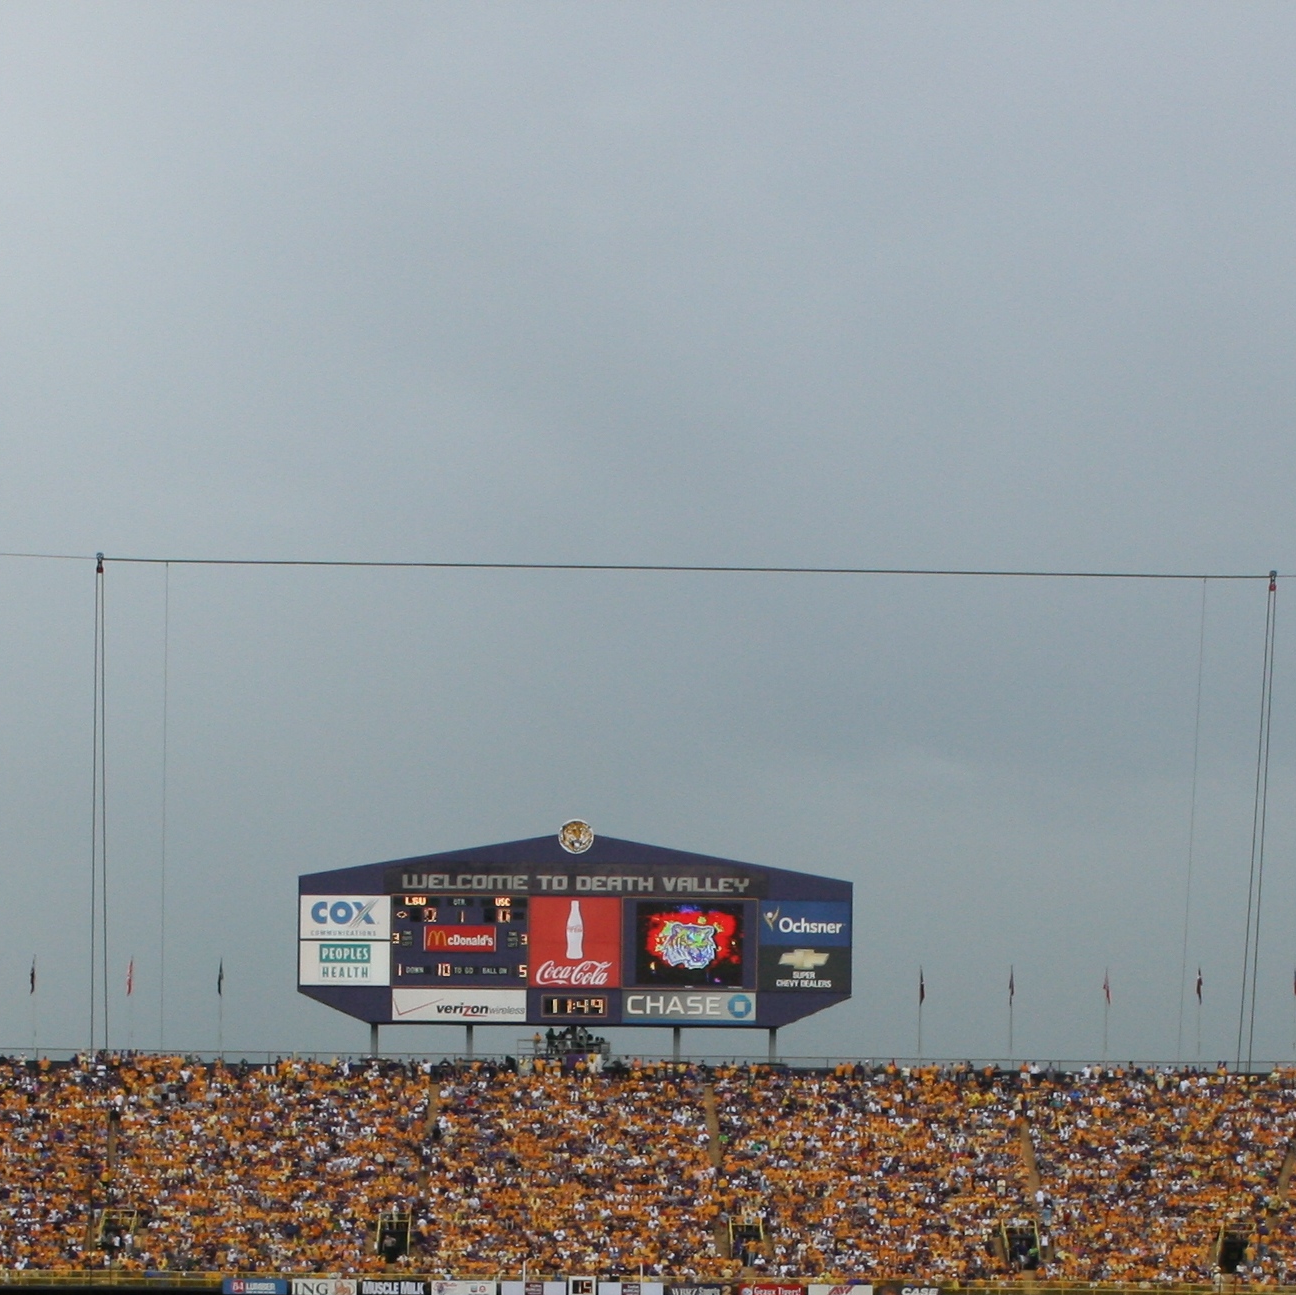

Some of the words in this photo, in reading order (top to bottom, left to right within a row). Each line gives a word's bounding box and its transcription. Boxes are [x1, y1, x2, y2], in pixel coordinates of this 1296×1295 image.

[402, 874, 528, 890] WELCOME
[536, 875, 568, 890] TO
[576, 876, 654, 892] DEATH
[663, 877, 750, 893] VALLEY
[405, 897, 427, 906] LSU
[495, 897, 511, 907] USC
[311, 900, 378, 926] COX
[778, 917, 842, 934] Ochsner
[427, 930, 494, 946] McDonald's
[322, 947, 369, 960] PEOPLES
[322, 966, 369, 978] HEALTH
[406, 966, 424, 974] DOWN
[438, 963, 451, 976] 10
[454, 966, 462, 974] TO
[465, 966, 474, 974] GO
[518, 965, 527, 978] 5
[536, 960, 612, 985] Coca-Cola
[792, 971, 815, 980] SUPER
[776, 979, 799, 988] CHEVY
[800, 979, 832, 988] DEALERS
[436, 1003, 489, 1017] verizon
[489, 1006, 525, 1015] wireless
[626, 995, 722, 1015] CHASE
[232, 1282, 244, 1291] 84
[246, 1282, 276, 1291] LUMBER
[295, 1282, 328, 1295] ING
[362, 1281, 399, 1295] MUSCLE
[400, 1282, 424, 1295] MILK
[578, 1280, 592, 1294] 15
[754, 1286, 777, 1295] Geaux
